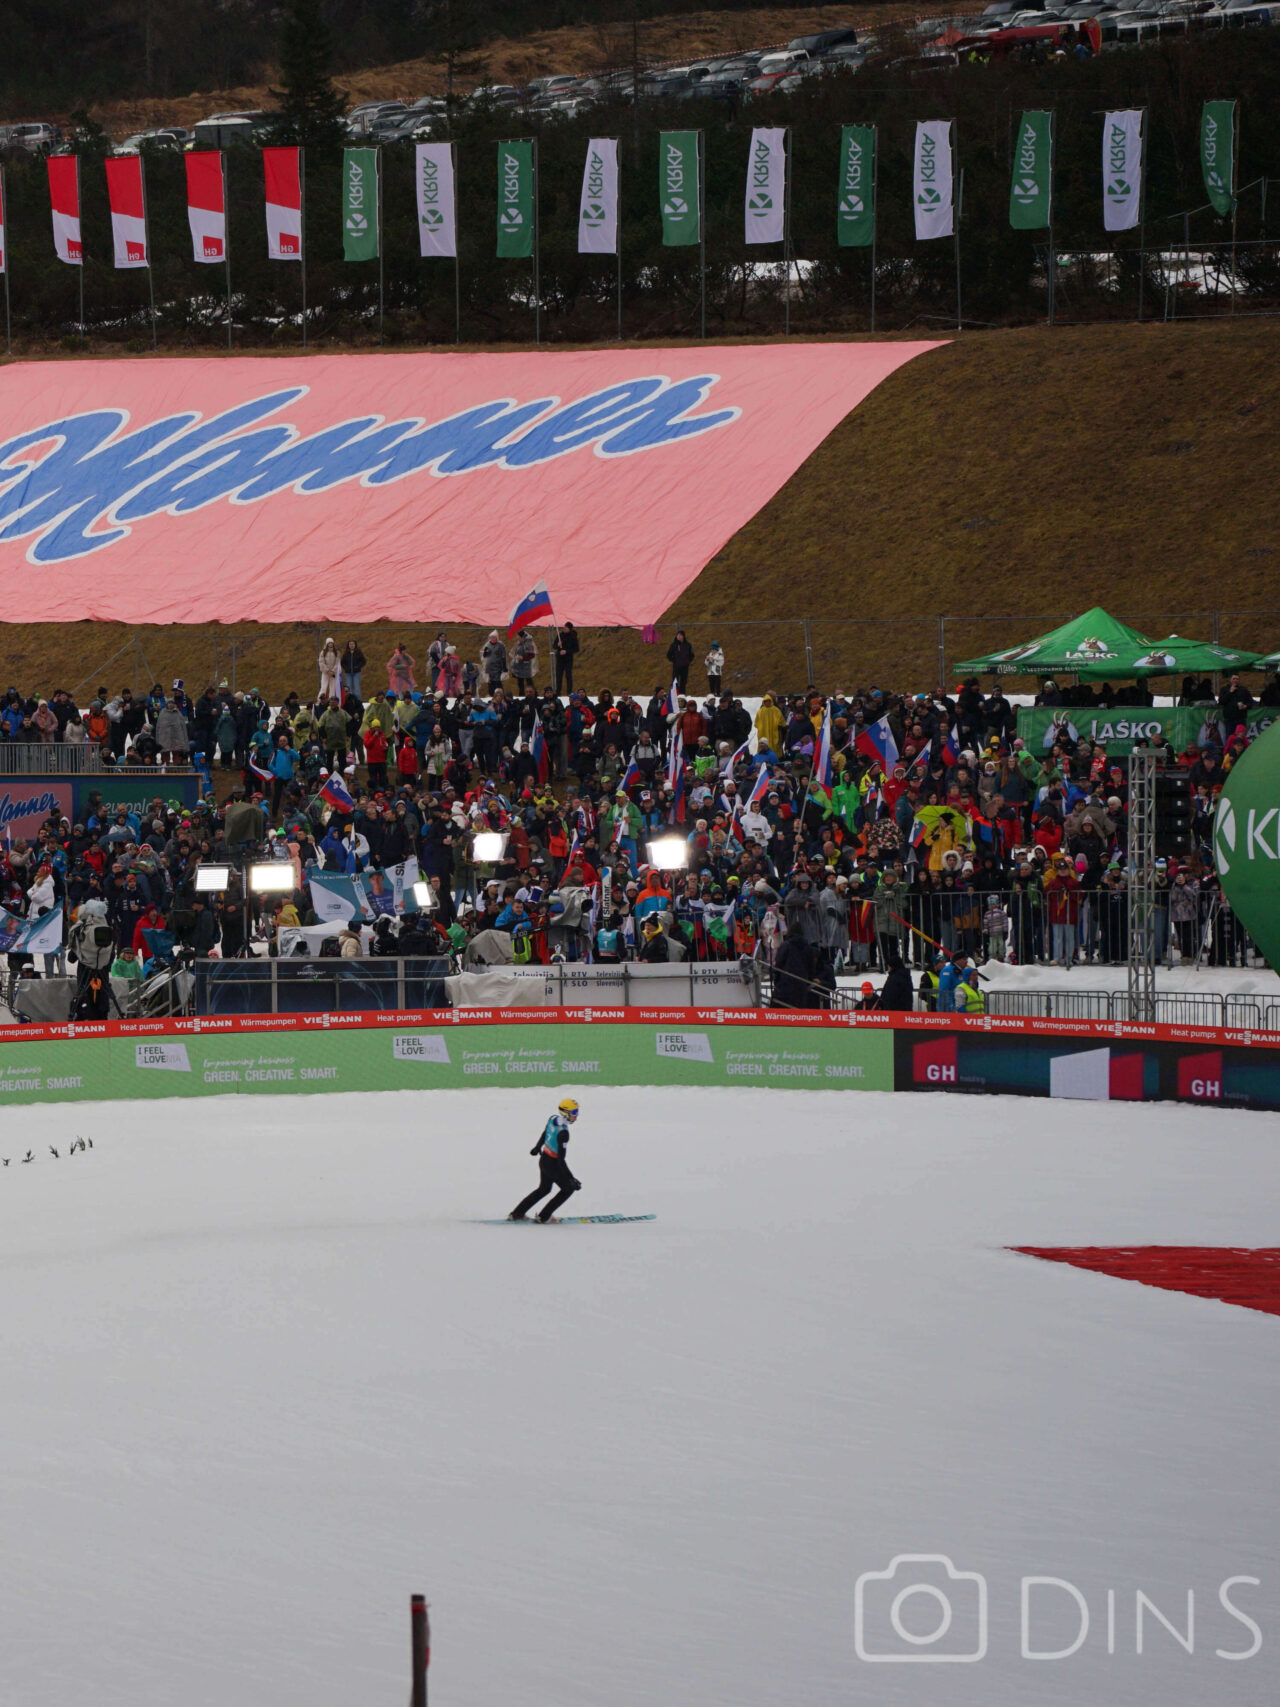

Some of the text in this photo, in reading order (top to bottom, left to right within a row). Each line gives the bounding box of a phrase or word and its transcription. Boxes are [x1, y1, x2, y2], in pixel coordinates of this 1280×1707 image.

[1091, 718, 1162, 745] LAŠKO
[50, 1024, 106, 1038] VIESSMANN
[120, 1023, 137, 1031] Heat
[139, 1022, 164, 1033] pumps
[175, 1018, 233, 1032] VIESSMANN
[240, 1016, 297, 1027] Wärmepumpen
[304, 1014, 362, 1027] VIESSMANN
[377, 1014, 394, 1022] Heat
[396, 1014, 422, 1024] pumps
[433, 1010, 493, 1023] VIESSMANN
[500, 1010, 557, 1021] Wärmepumpen
[565, 1008, 625, 1022] VIESSMANN
[640, 1011, 658, 1019] Heat
[660, 1012, 686, 1021] pumps
[697, 1009, 757, 1023] VIESSMANN
[765, 1012, 822, 1023] Wärmepumpen
[829, 1012, 889, 1026] VIESSMANN
[905, 1016, 923, 1024] Heat
[925, 1017, 951, 1026] pumps
[964, 1016, 1024, 1030] VIESSMANN
[1032, 1021, 1090, 1031] Wärmepumpen
[1095, 1022, 1156, 1036] VIESSMANN
[1171, 1028, 1188, 1037] Heat
[1191, 1030, 1216, 1039] pumps
[402, 1038, 422, 1047] FEEL
[144, 1047, 164, 1055] FEEL
[463, 1061, 600, 1074] GREEN. CREATIVE. SMART.
[726, 1064, 865, 1078] GREEN. CREATIVE. SMART.
[927, 1065, 955, 1081] GH
[204, 1068, 340, 1082] GREEN. CREATIVE. SMART.
[47, 1076, 84, 1089] SMART.
[1191, 1080, 1219, 1098] GH
